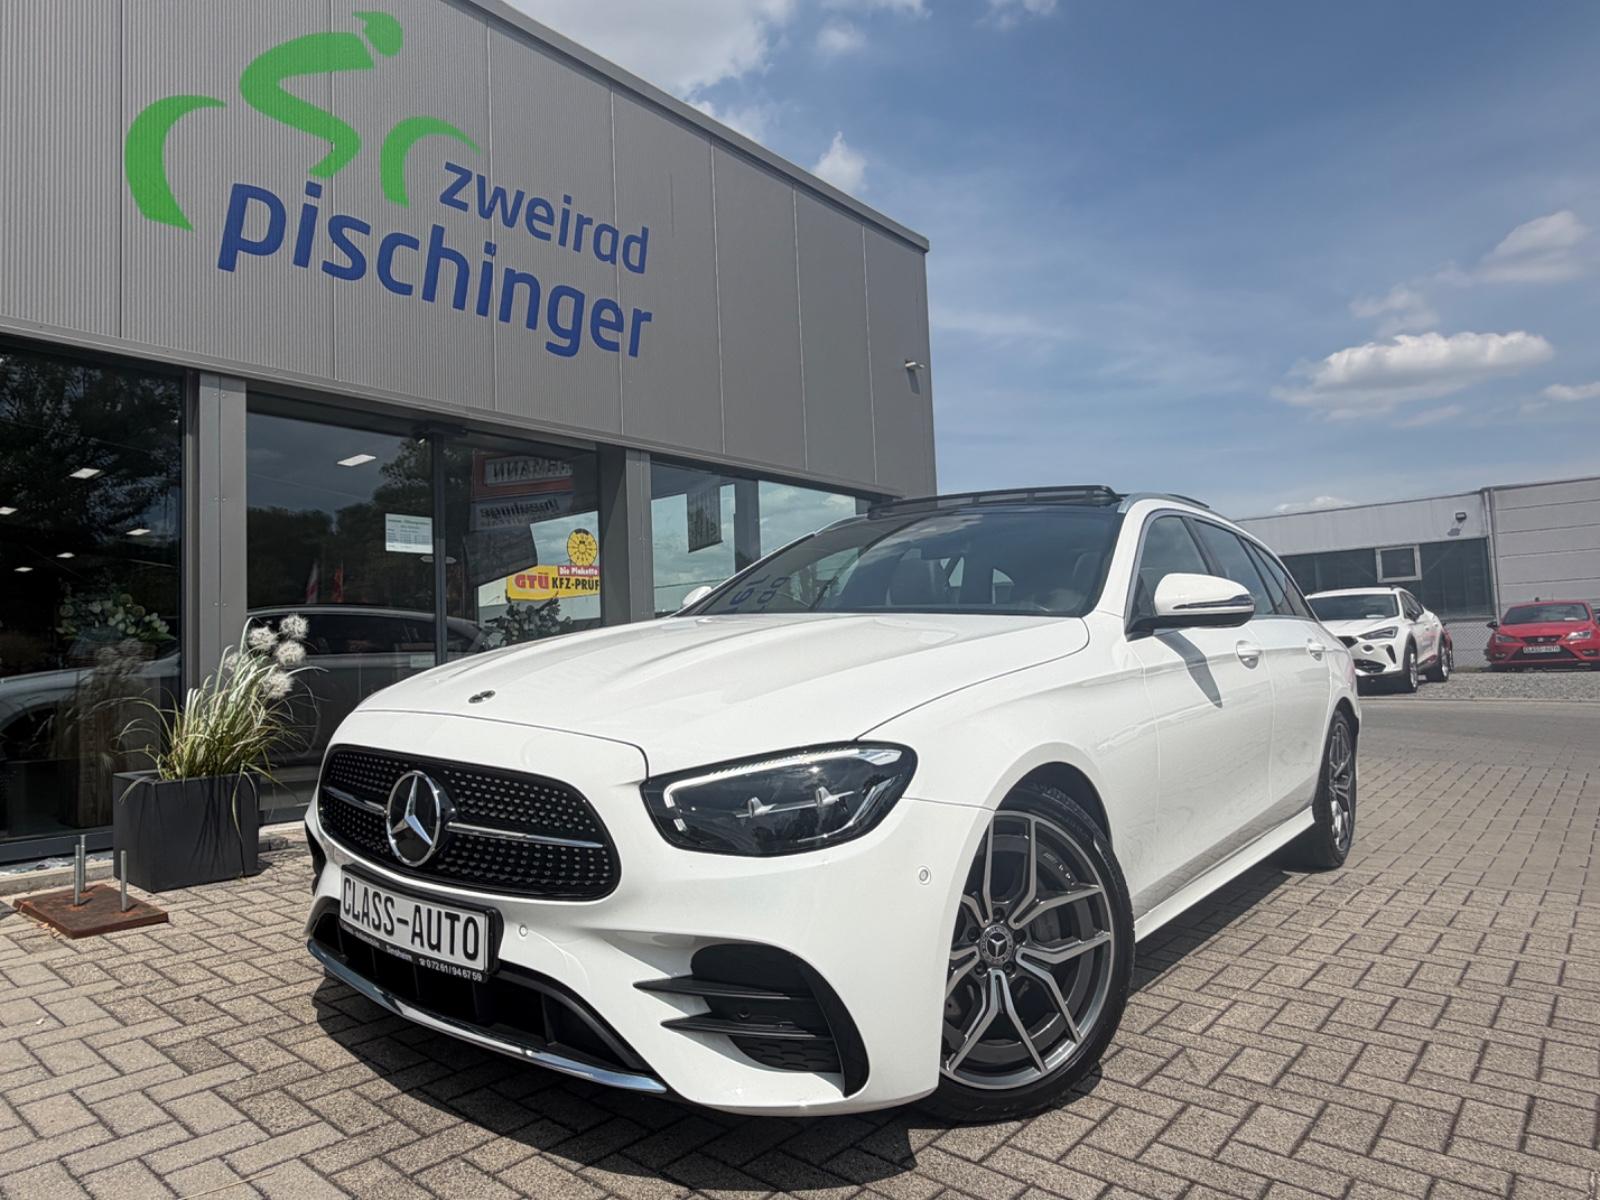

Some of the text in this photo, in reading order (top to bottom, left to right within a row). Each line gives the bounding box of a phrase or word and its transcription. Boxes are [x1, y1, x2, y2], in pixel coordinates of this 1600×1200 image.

[217, 181, 653, 358] pischinger
[439, 161, 649, 274] zweirad
[343, 877, 479, 961] CLASS-AUTO
